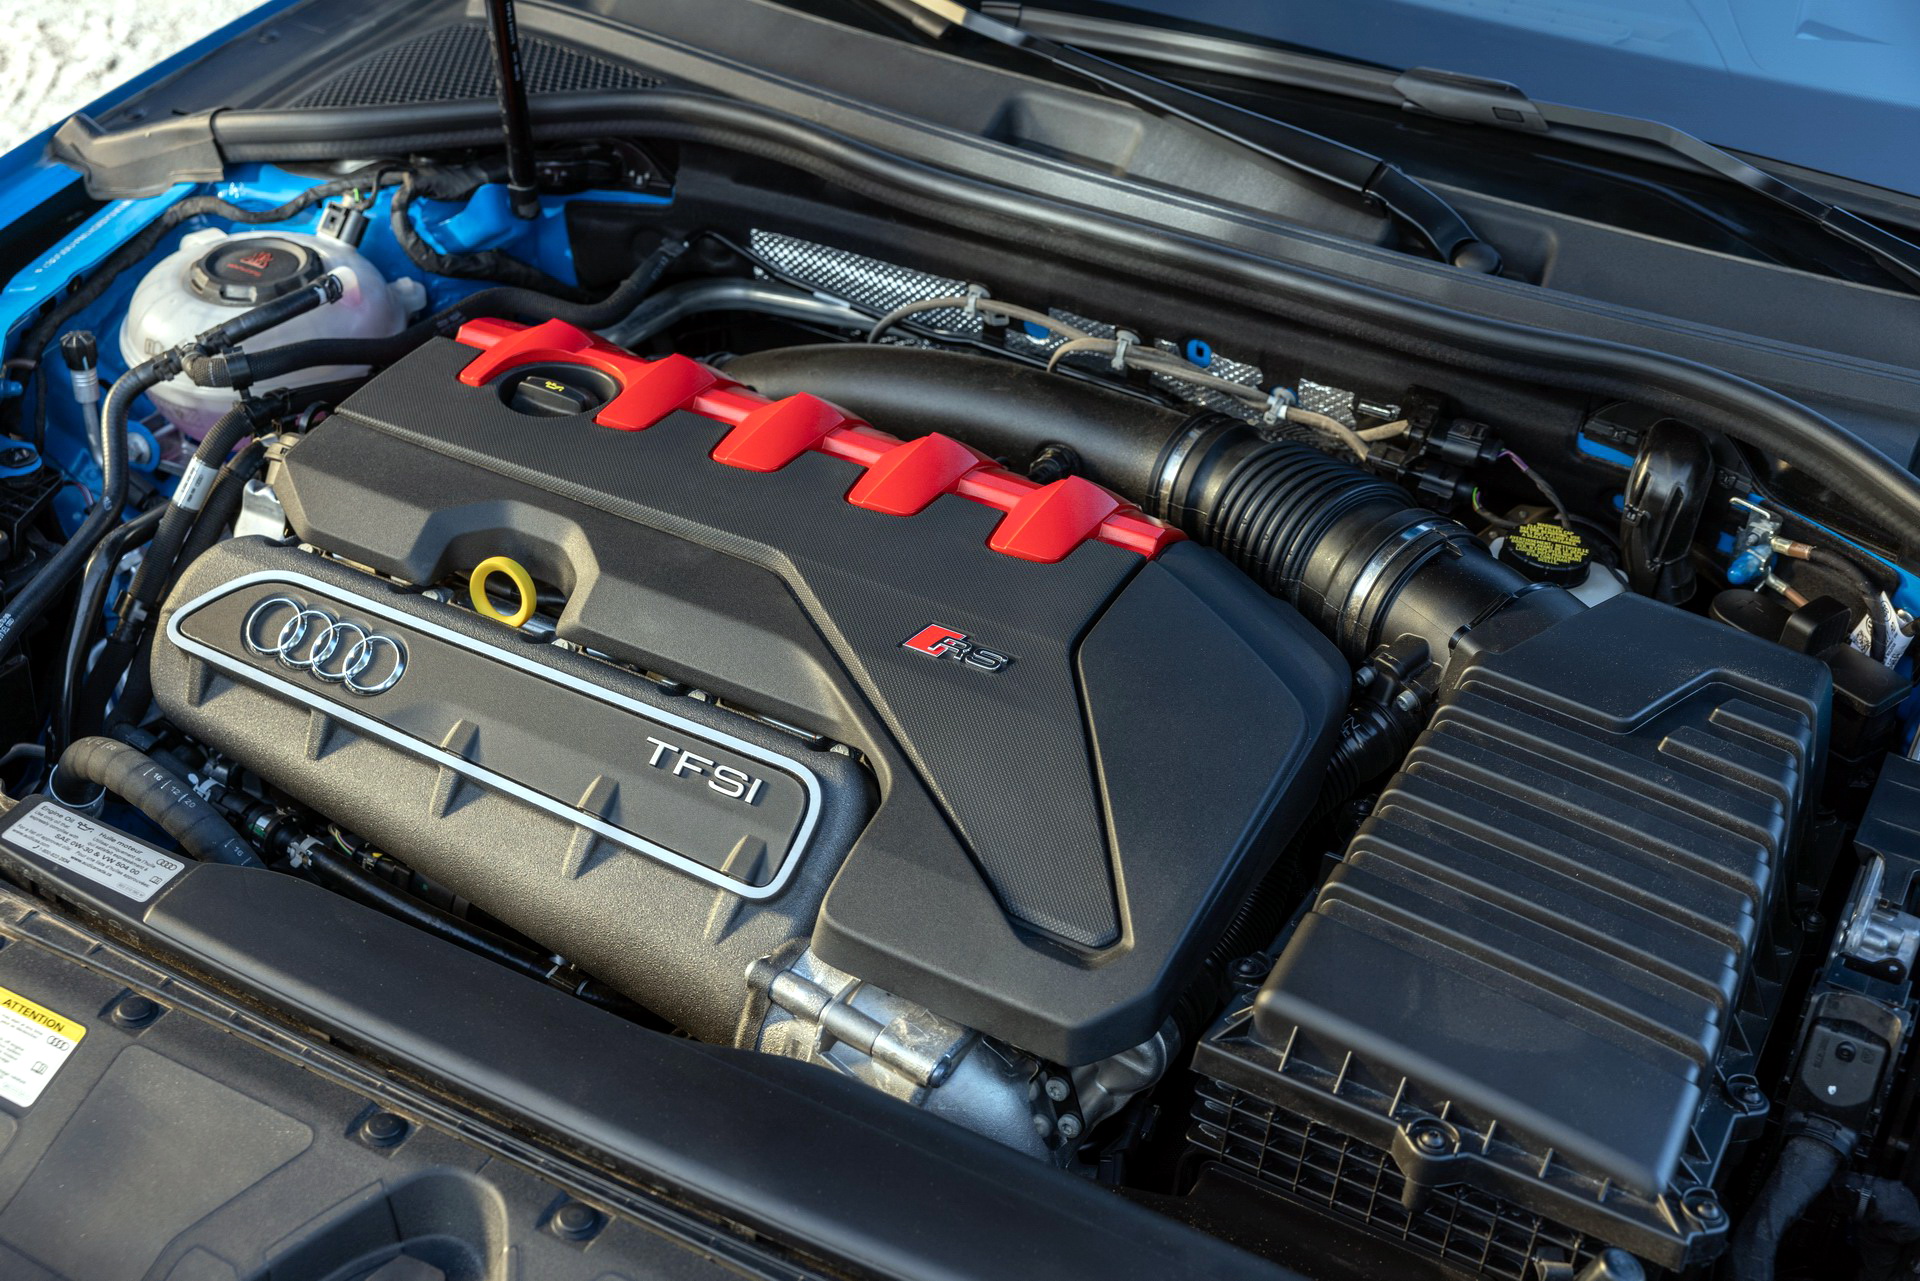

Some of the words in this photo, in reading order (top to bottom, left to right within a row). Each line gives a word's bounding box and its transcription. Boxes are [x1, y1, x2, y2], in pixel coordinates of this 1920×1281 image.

[903, 624, 1009, 670] RS
[647, 736, 762, 804] TFSI
[153, 772, 163, 781] 16
[184, 798, 196, 808] 20
[40, 805, 65, 818] Engine
[63, 815, 75, 823] Oil
[53, 833, 71, 843] SAE
[69, 840, 93, 854] 0W-30
[100, 855, 115, 864] VW
[114, 861, 129, 871] 504
[129, 868, 140, 876] 00
[98, 832, 117, 843] Huile
[116, 840, 143, 855] moteur
[3, 999, 65, 1032] ATTENTION
